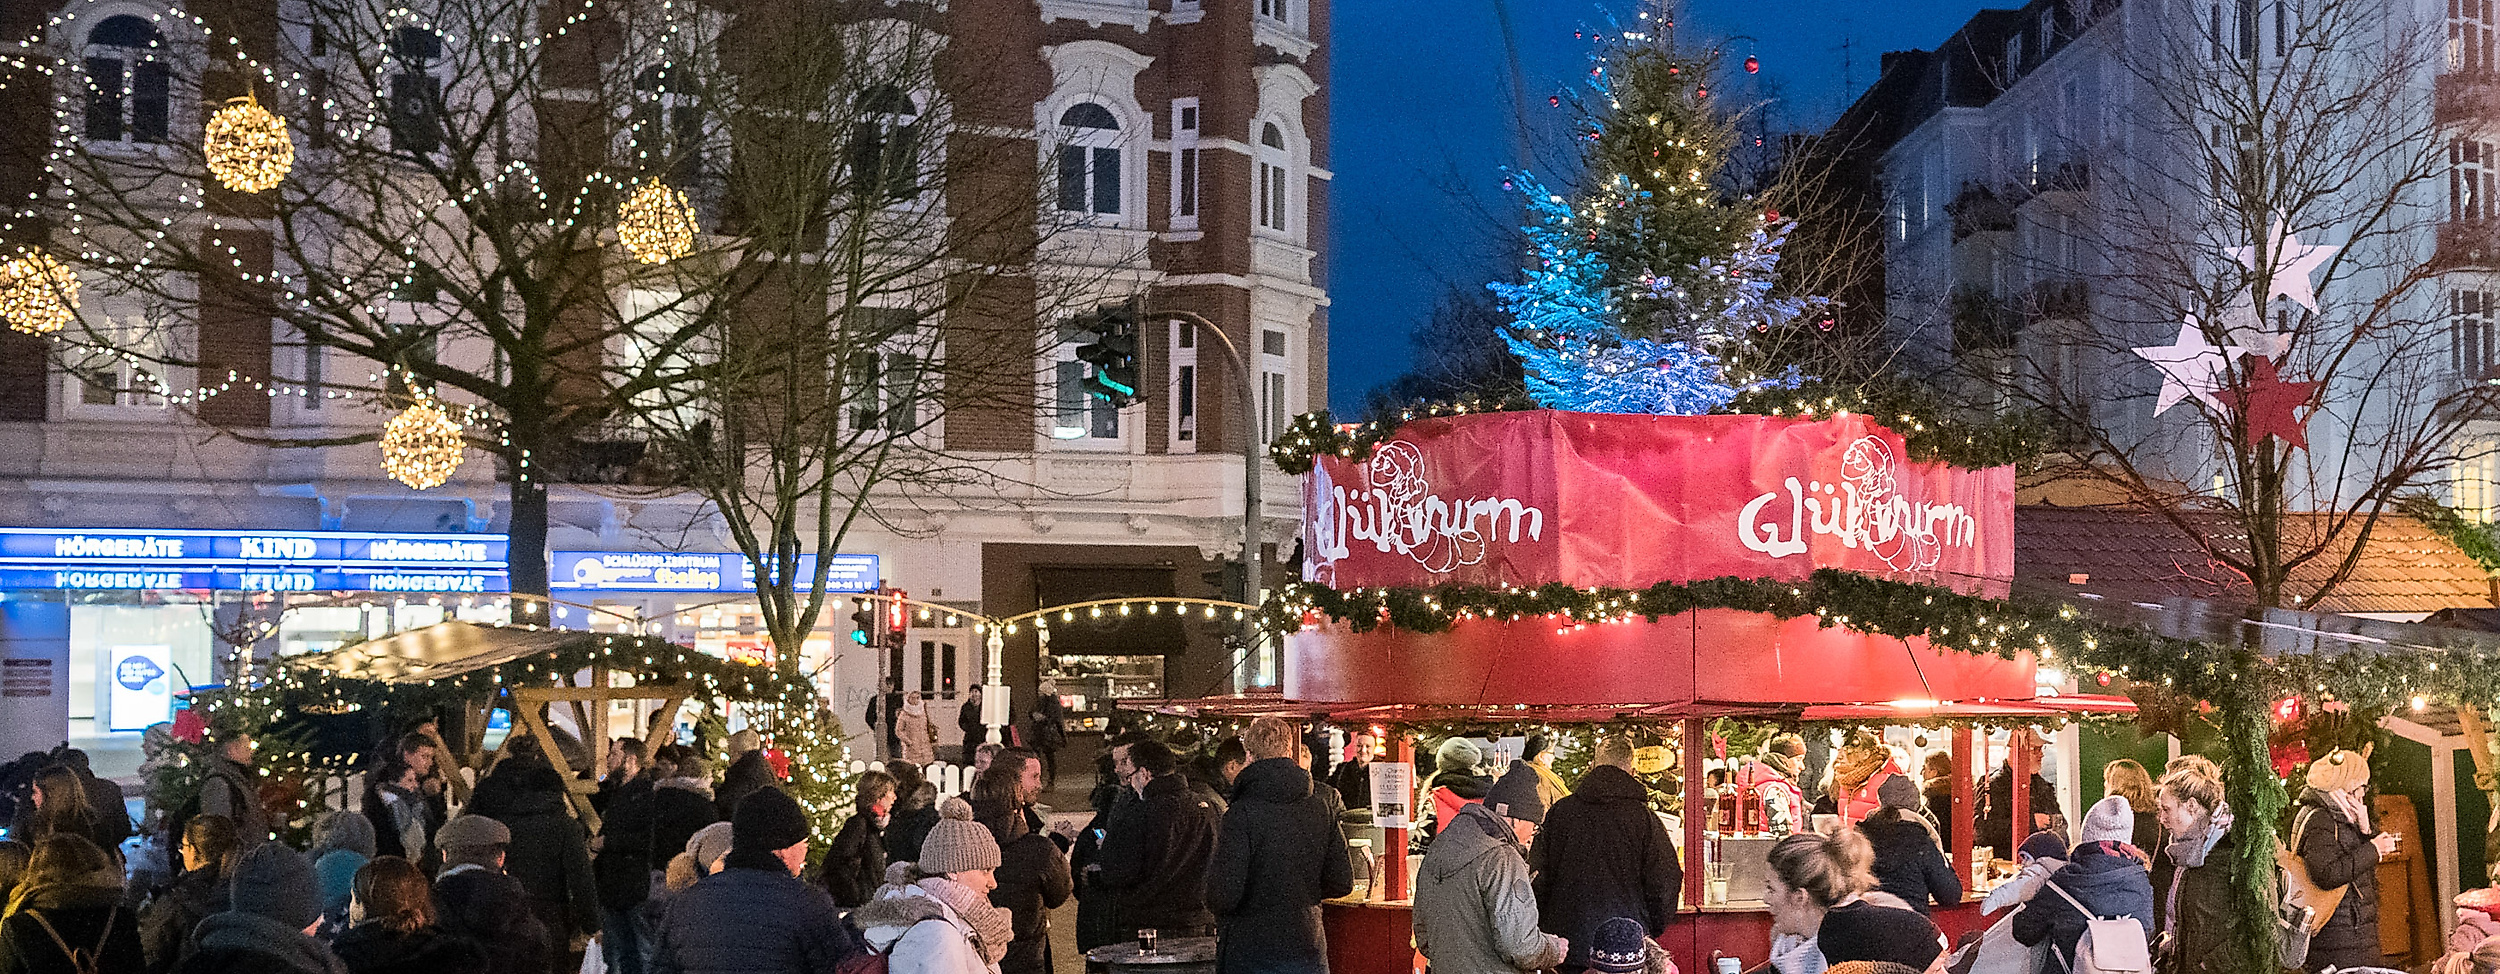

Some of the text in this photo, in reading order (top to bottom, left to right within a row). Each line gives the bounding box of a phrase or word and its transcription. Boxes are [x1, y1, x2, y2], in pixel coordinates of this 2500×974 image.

[55, 535, 487, 561] HÖRGERÄTE KIND HÖRGERÄTE
[602, 554, 720, 568] SCHLÜSSELZENTRUM
[653, 567, 721, 590] Ebeling
